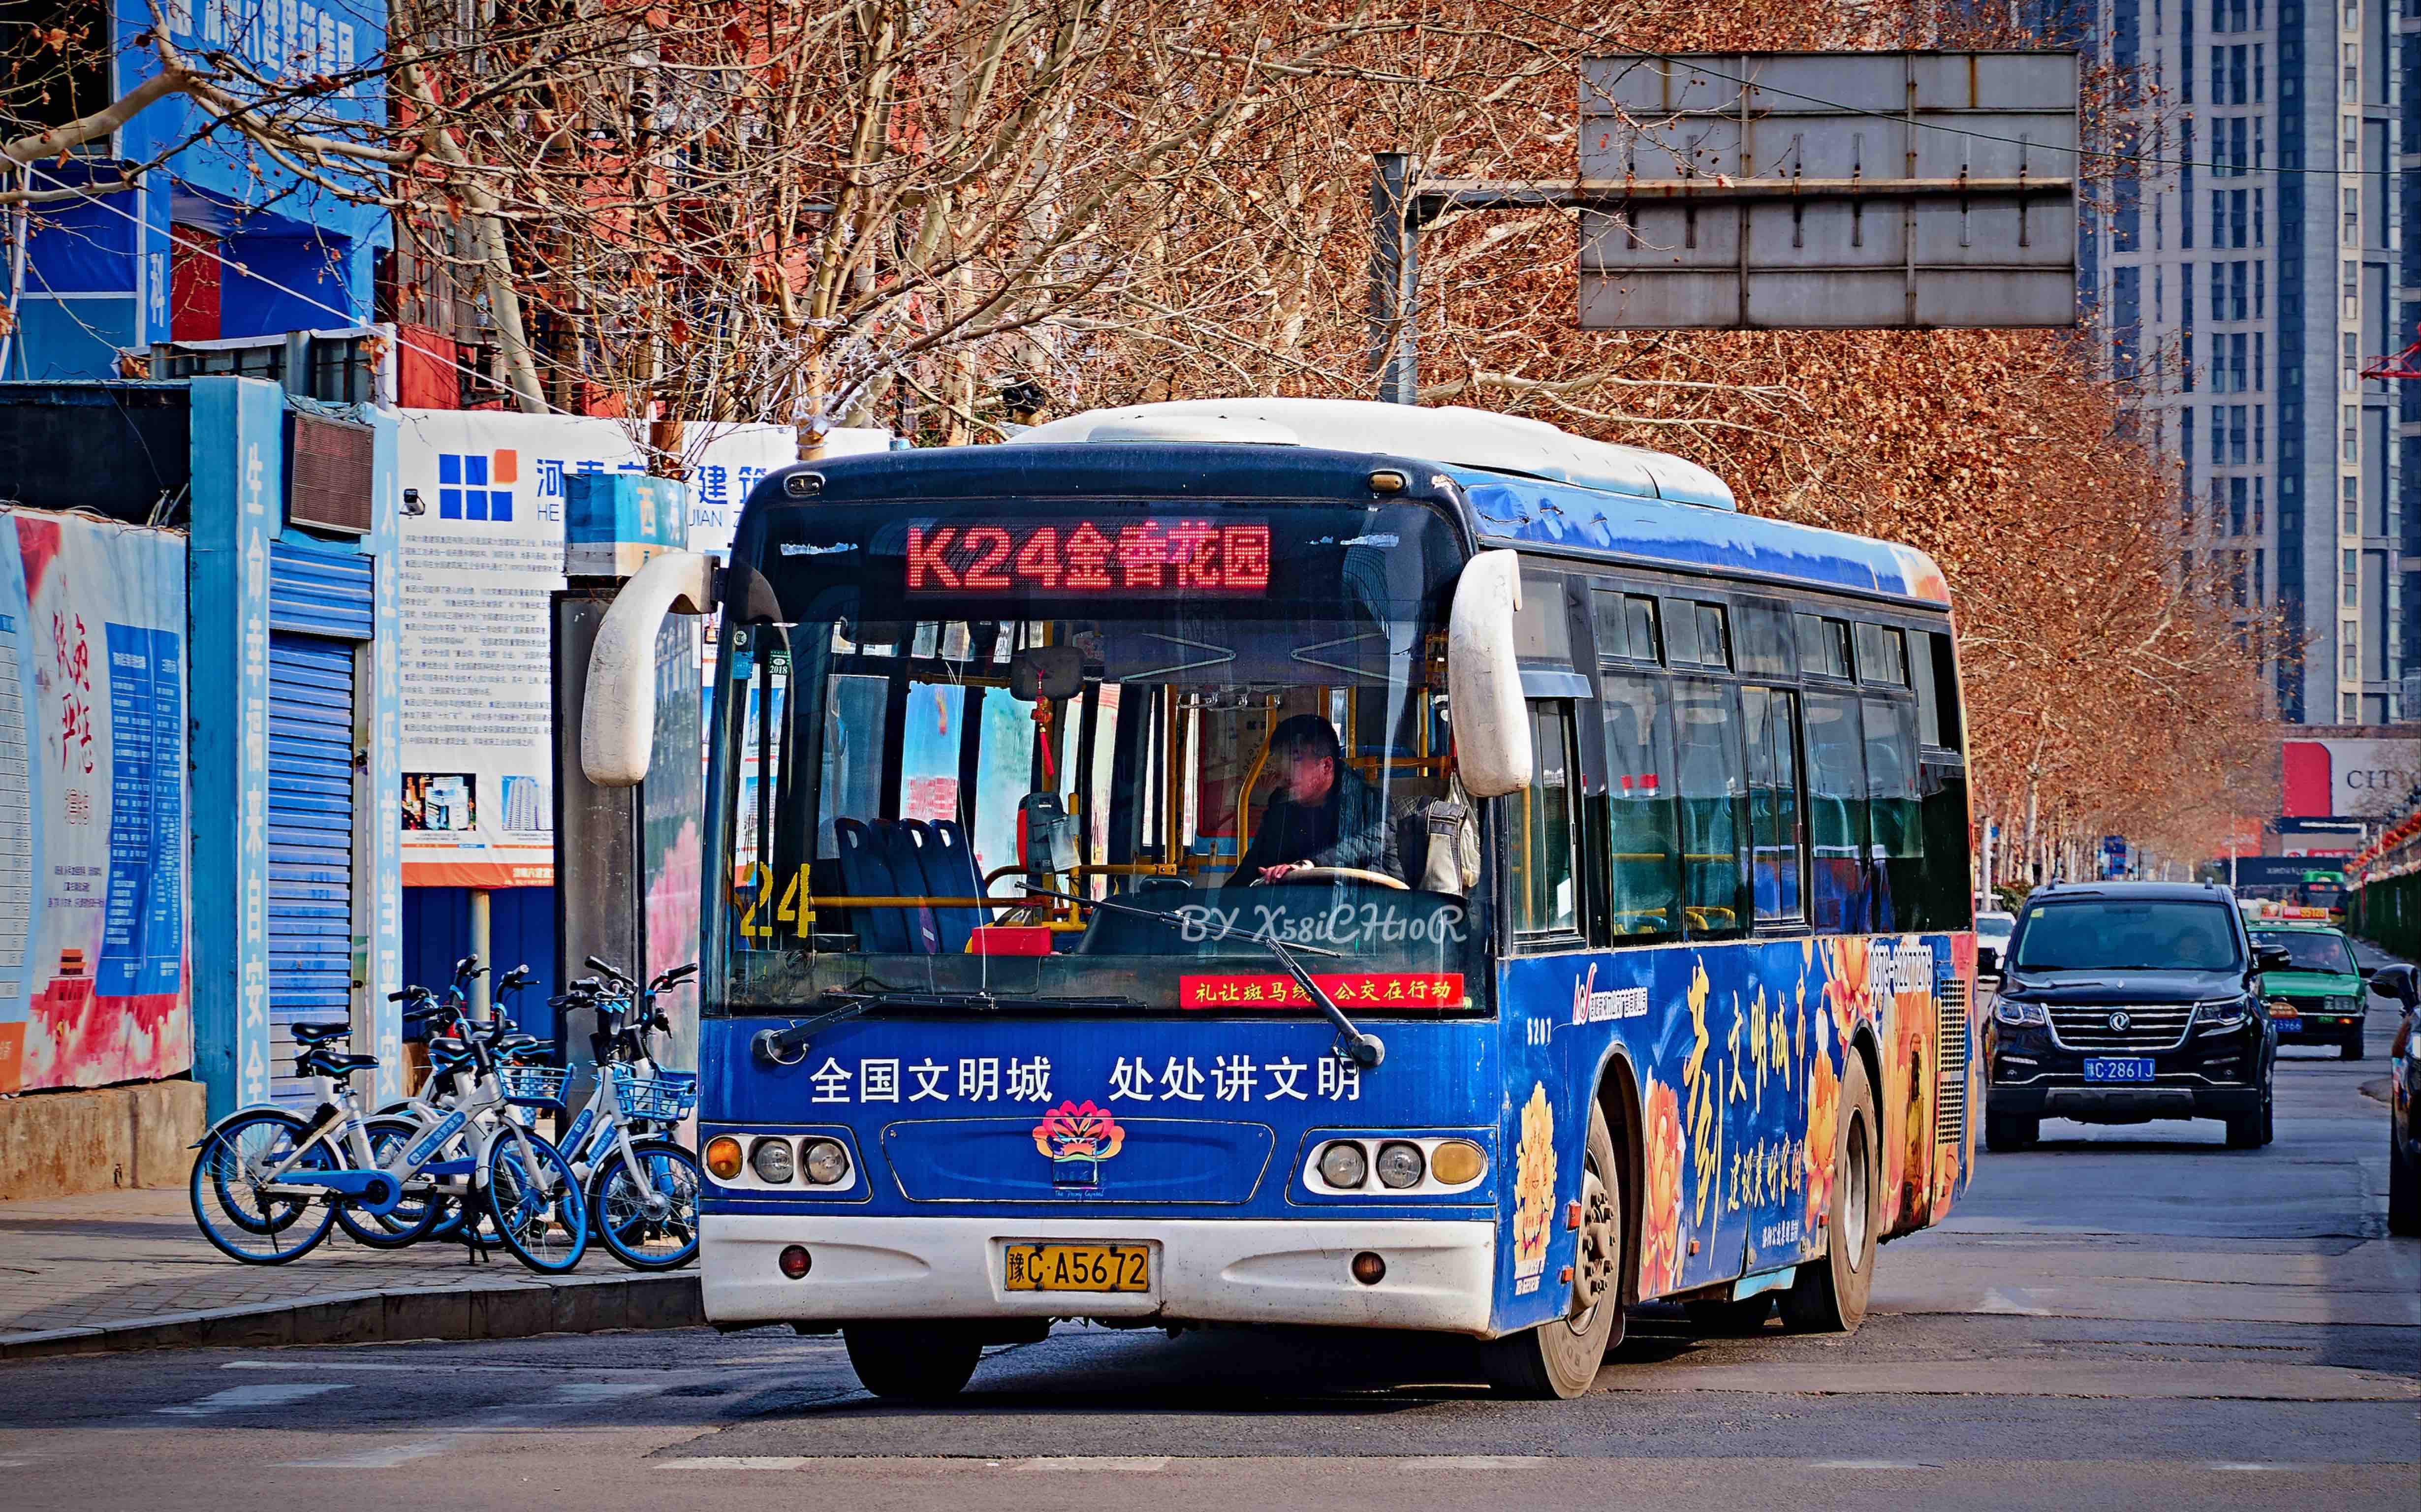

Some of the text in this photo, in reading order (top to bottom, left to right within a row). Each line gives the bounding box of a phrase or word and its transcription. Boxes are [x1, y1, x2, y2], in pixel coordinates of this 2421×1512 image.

[908, 520, 1269, 588] K24金香花园
[769, 665, 788, 674] 2018
[247, 442, 264, 1102] 生命幸福来自安全
[740, 861, 816, 938] 24
[1195, 979, 1452, 1003] 礼让斑马线 公交在行动
[1728, 963, 1806, 1121] 文明城市
[809, 1055, 1361, 1103] 全国文明城 处处讲文明
[1009, 1252, 1145, 1285] 豫C·A5672
